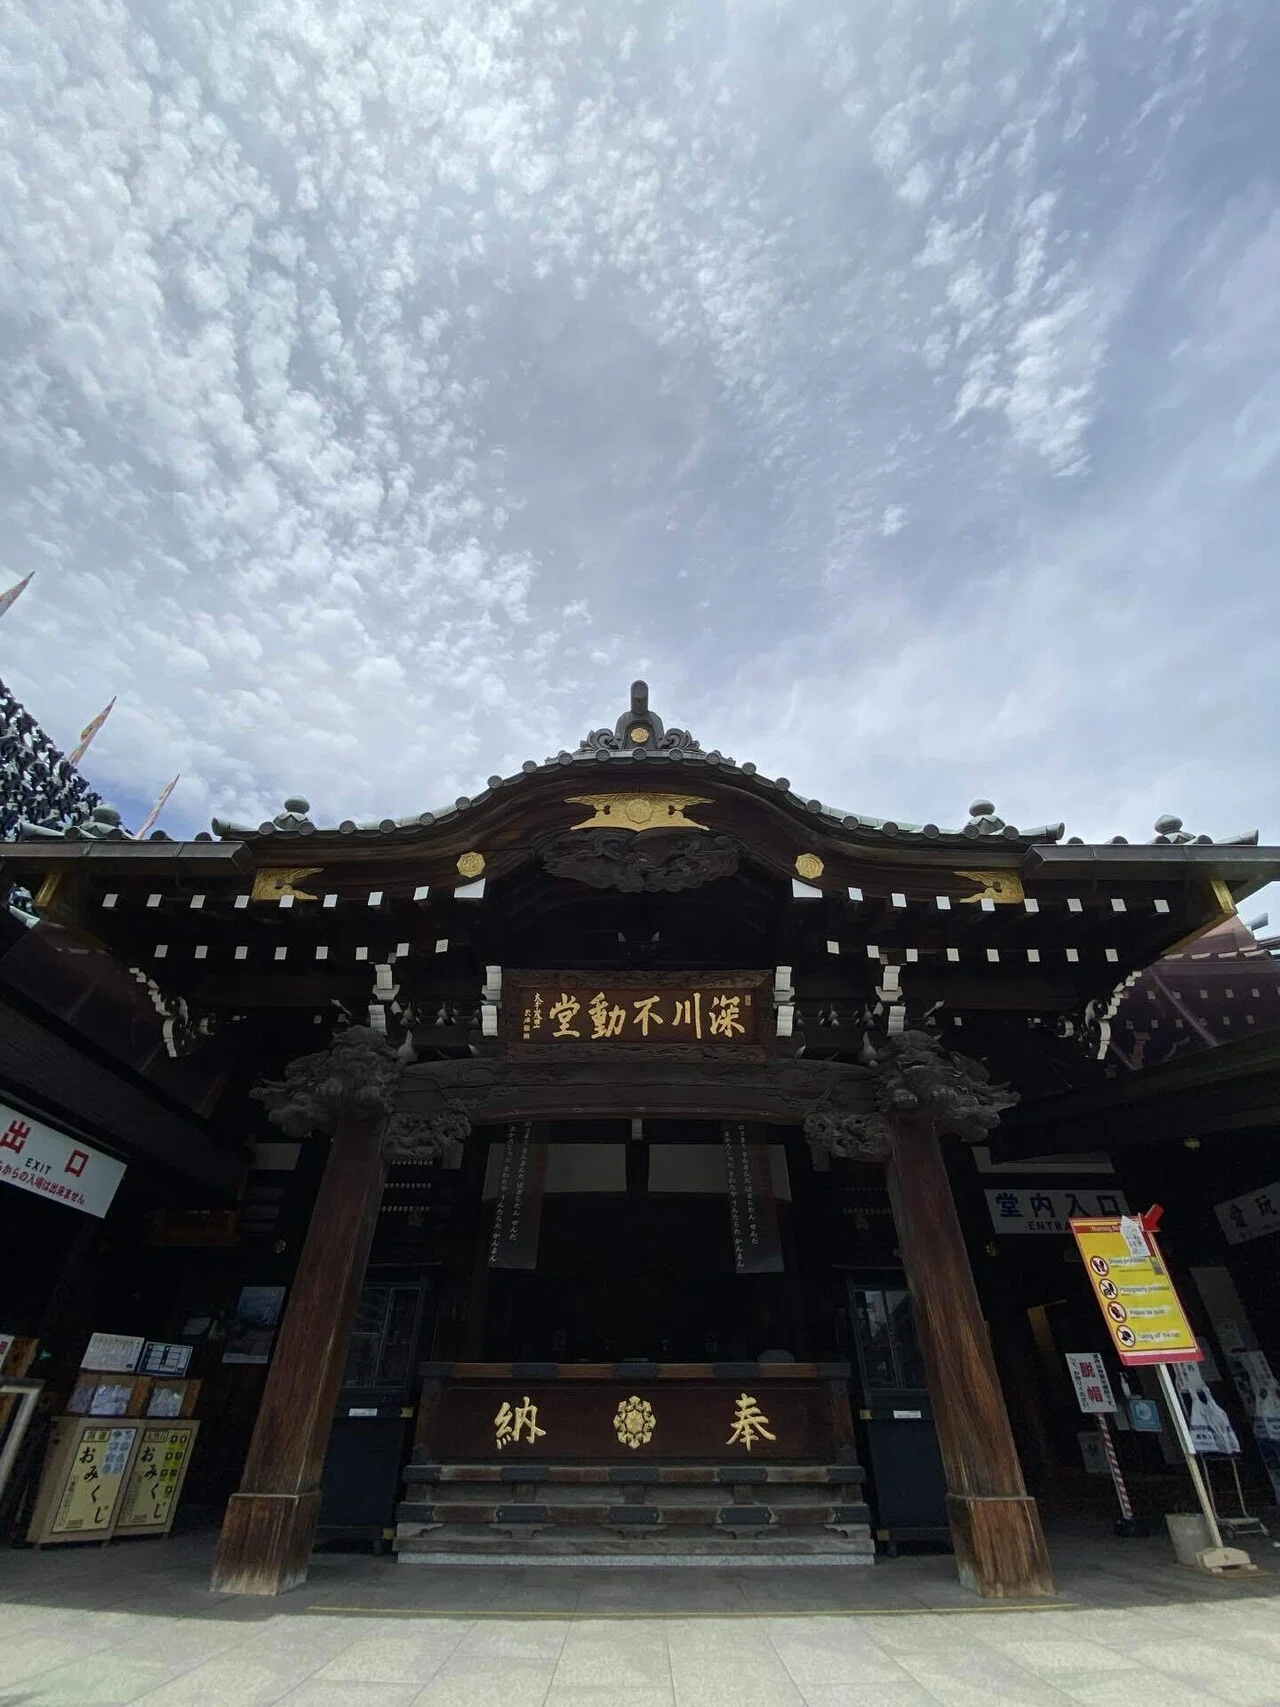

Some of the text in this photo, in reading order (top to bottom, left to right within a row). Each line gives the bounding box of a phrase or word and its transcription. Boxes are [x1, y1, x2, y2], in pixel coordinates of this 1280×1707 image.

[549, 991, 746, 1040] 深川不動堂
[0, 1120, 91, 1178] 出口
[25, 1157, 52, 1175] EXIT
[995, 1193, 1122, 1218] 堂内入口
[1028, 1221, 1072, 1231] ENTRA
[1079, 1361, 1104, 1403] 脱帽
[79, 1446, 109, 1524] おみくじ
[141, 1446, 168, 1519] おみくじ
